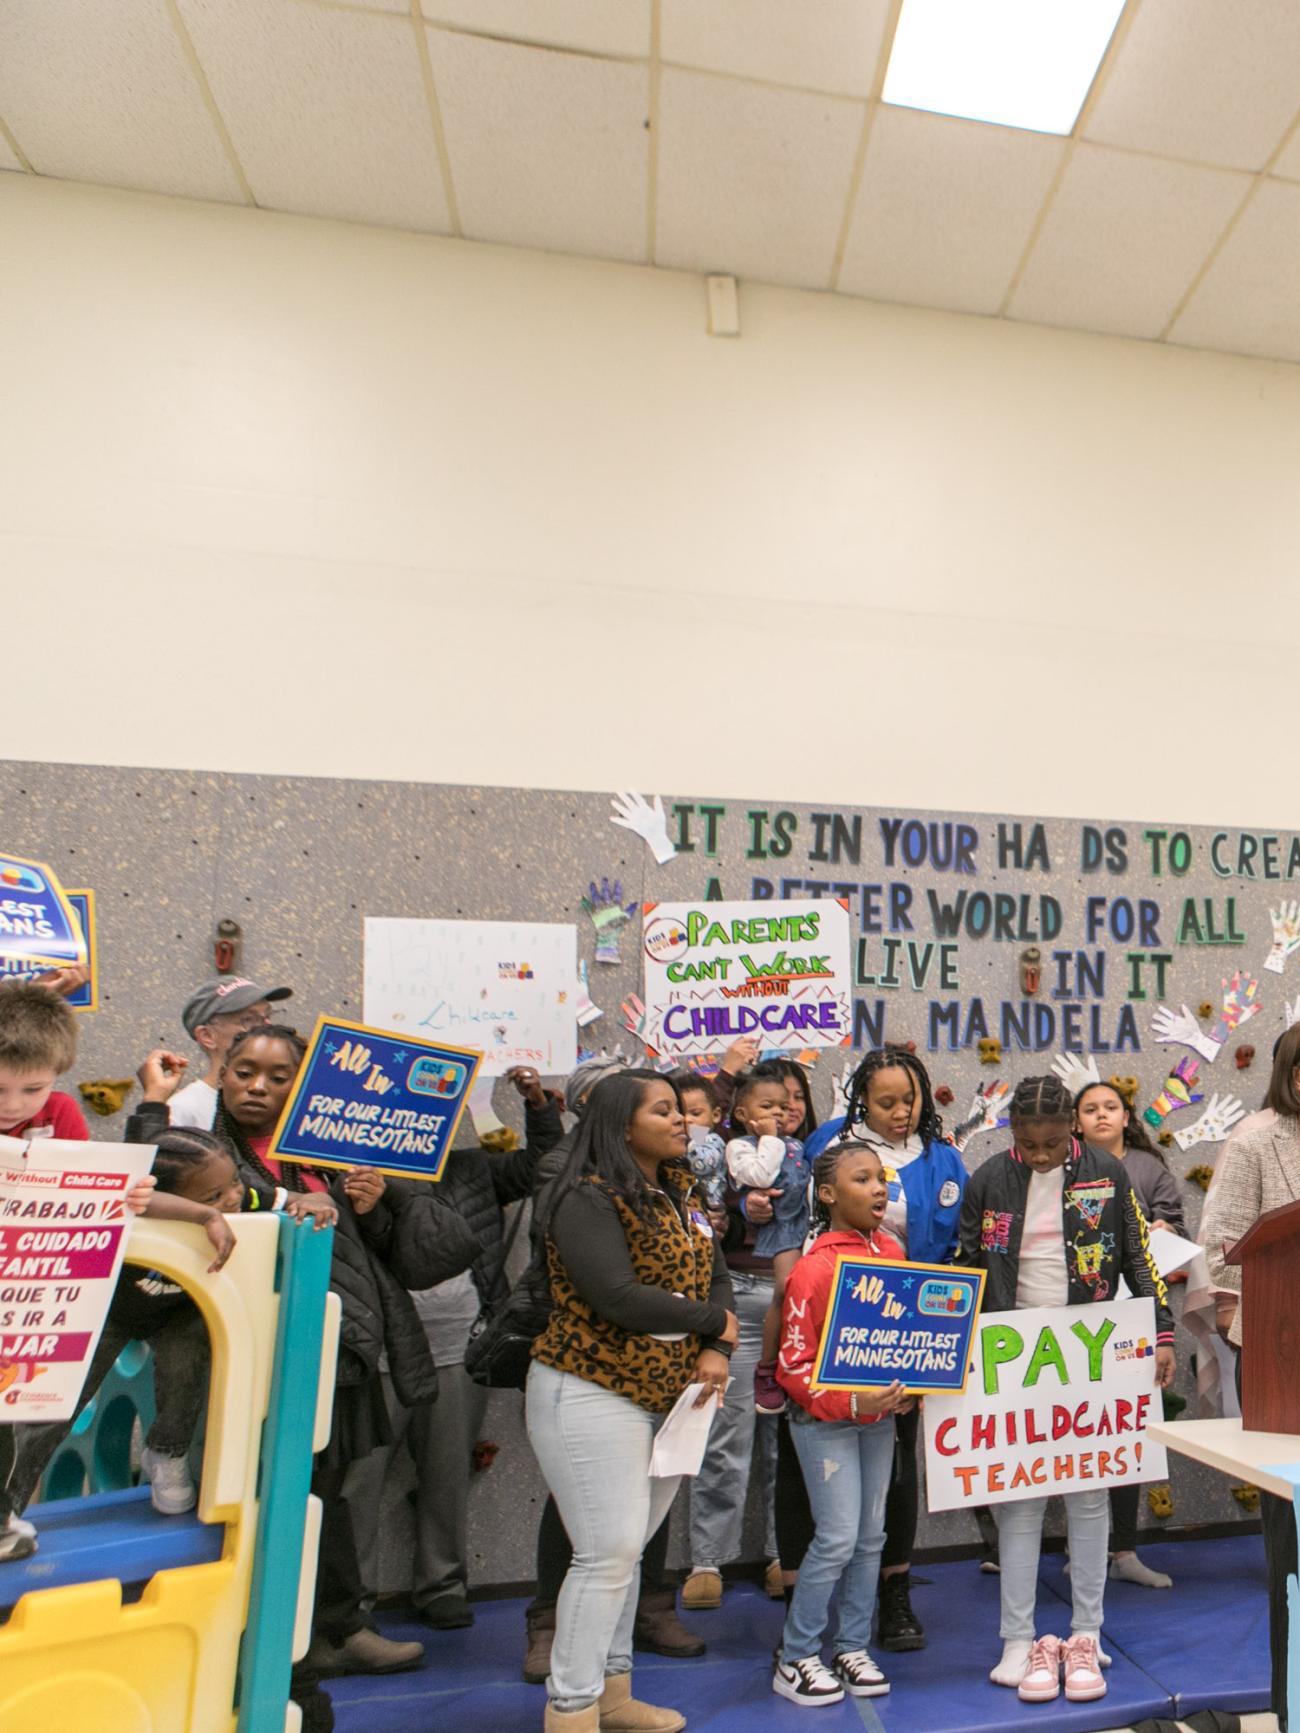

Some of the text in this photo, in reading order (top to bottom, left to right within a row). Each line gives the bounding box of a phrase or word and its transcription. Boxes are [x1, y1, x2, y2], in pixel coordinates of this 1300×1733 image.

[673, 804, 725, 857] IT
[746, 810, 797, 858] IS
[809, 813, 862, 864] IN
[879, 817, 978, 873] YOUR
[1143, 829, 1192, 876] TO
[687, 911, 820, 946] PARENTS
[927, 888, 1062, 942] WORLD
[1086, 896, 1161, 946] FOR
[1176, 897, 1247, 944] ALL
[667, 952, 831, 982] CAN'T WORK
[1052, 951, 1105, 999] IN
[1126, 953, 1173, 1000] IT
[720, 980, 790, 998] WITHOUT
[663, 1002, 841, 1039] CHILDCARE
[928, 999, 1141, 1053] MANDELA
[330, 1040, 394, 1095] All In
[420, 1062, 443, 1073] KIDS
[308, 1095, 445, 1133] FOR OUR LITTLEST
[298, 1115, 439, 1155] MINNESOTANS
[64, 1174, 94, 1186] Child
[95, 1175, 123, 1187] Care
[16, 1231, 113, 1251] CUIDADO
[0, 1286, 81, 1303] QUE TU
[852, 1274, 907, 1320] All In
[927, 1284, 948, 1295] KIDS
[22, 1310, 45, 1326] IR
[52, 1310, 67, 1326] A
[0, 1335, 59, 1357] JAR
[839, 1326, 961, 1350] FOR OUR LITTLEST
[1113, 1339, 1134, 1350] KIDS
[834, 1346, 957, 1372] MINNESOTANS
[981, 1317, 1117, 1396] PAY
[935, 1394, 1151, 1456] CHILDCARE
[953, 1441, 1142, 1497] TEACHERS!
